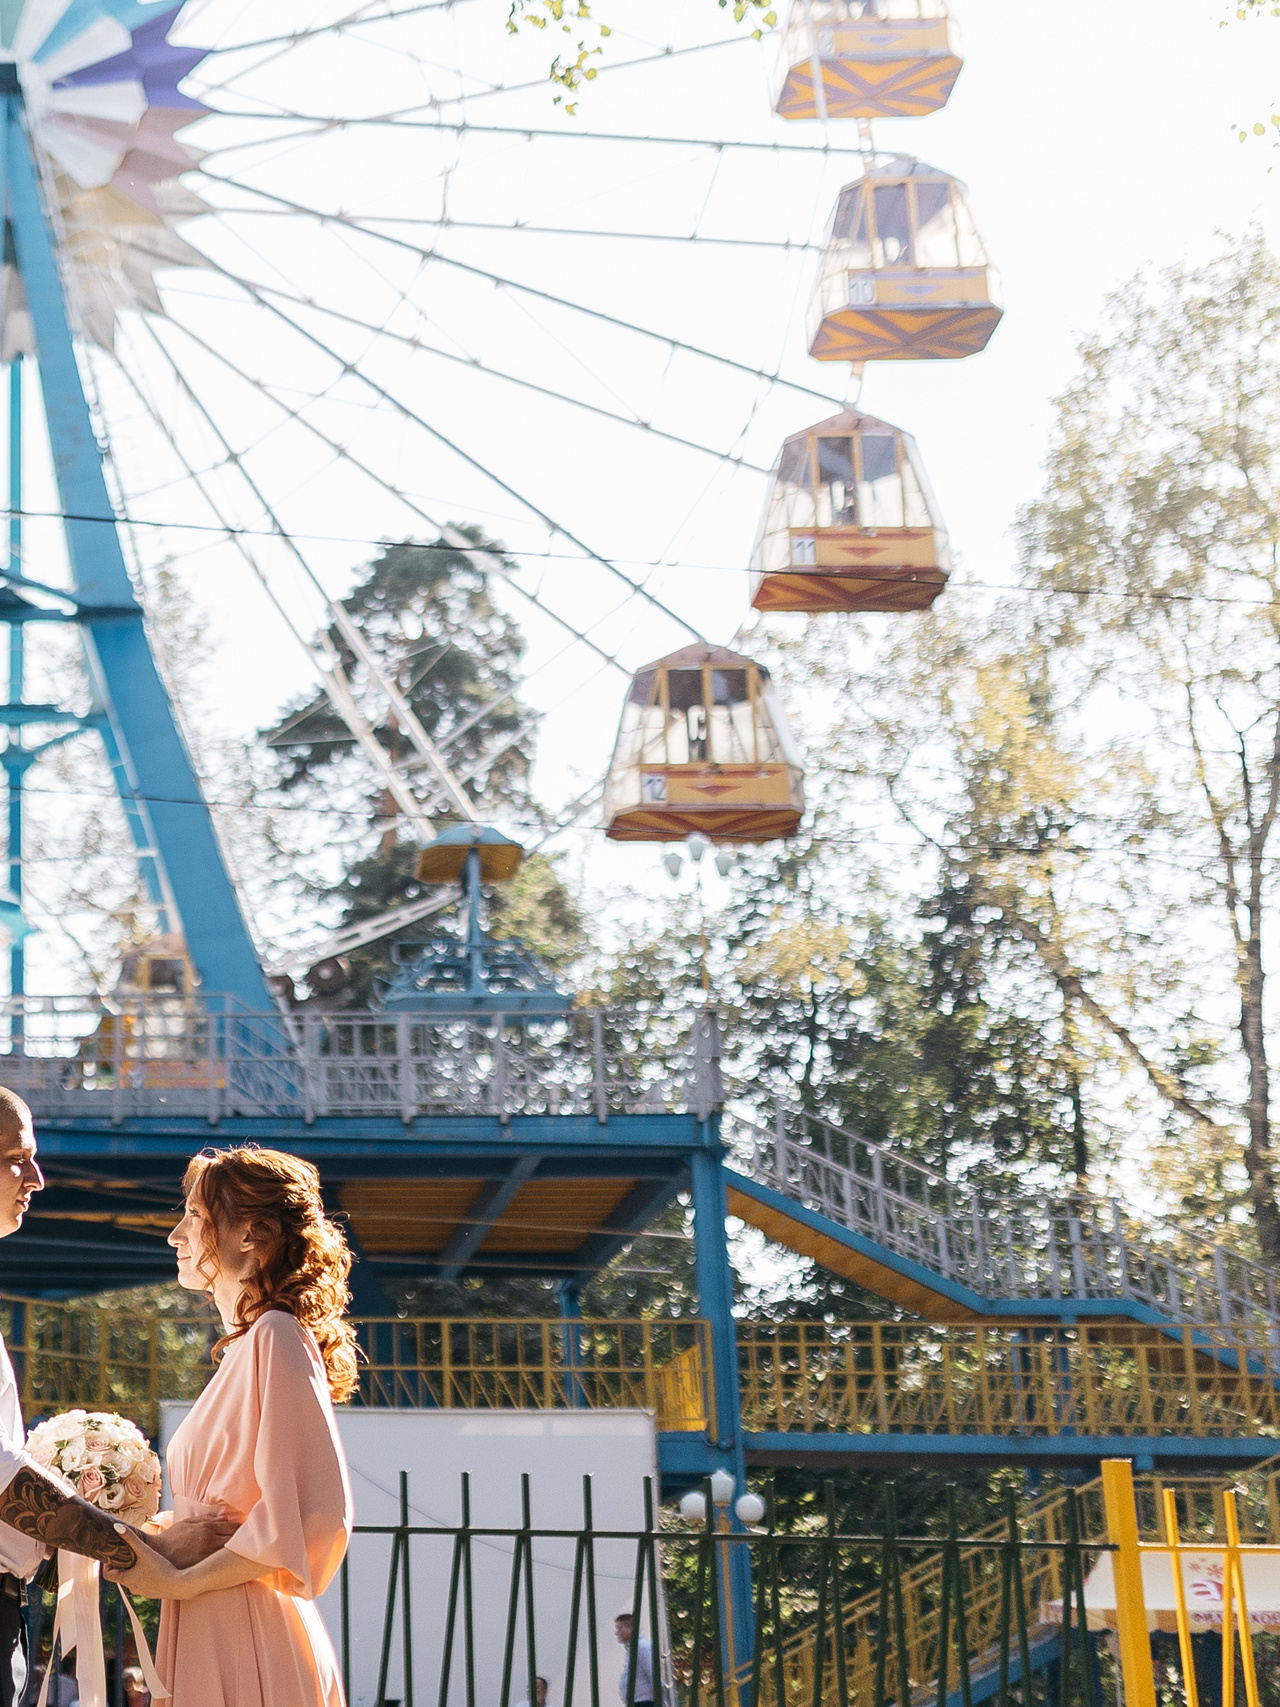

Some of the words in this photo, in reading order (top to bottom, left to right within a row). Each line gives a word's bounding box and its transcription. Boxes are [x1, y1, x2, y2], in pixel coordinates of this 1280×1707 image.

[850, 281, 874, 303] 10
[793, 540, 816, 564] 11
[644, 778, 666, 801] 12
